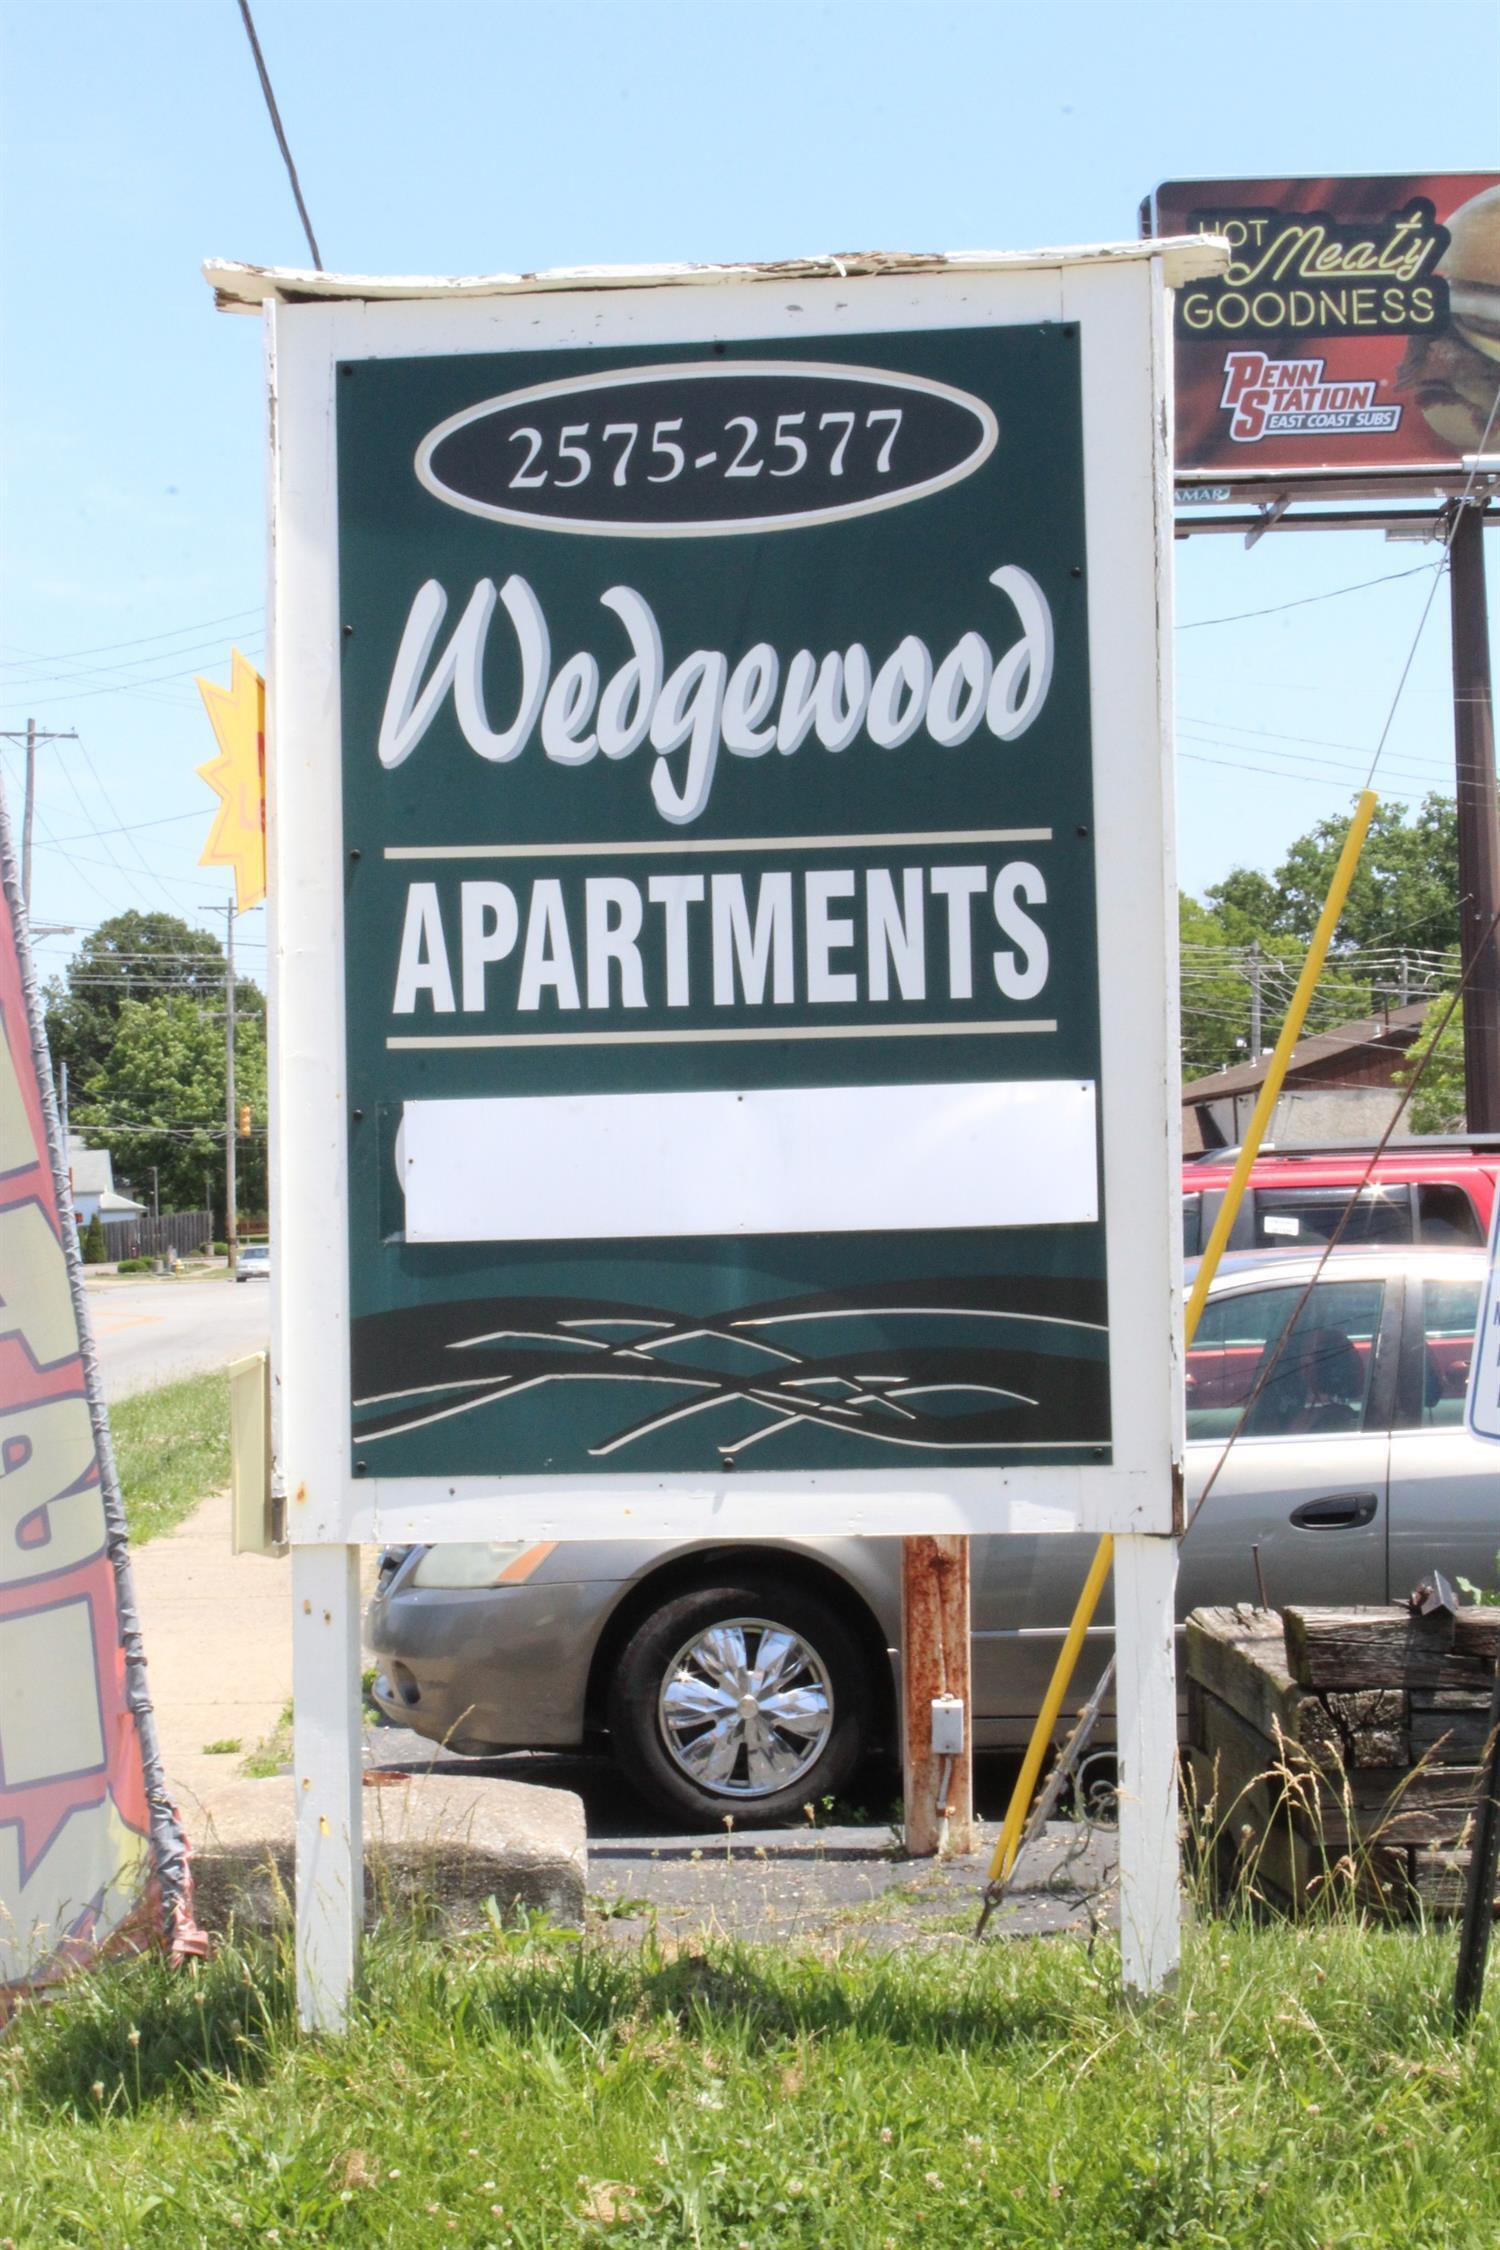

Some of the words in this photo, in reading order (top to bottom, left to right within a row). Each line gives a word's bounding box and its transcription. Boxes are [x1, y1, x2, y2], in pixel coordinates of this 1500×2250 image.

[1199, 220, 1269, 248] HOT
[1223, 211, 1435, 287] Meaty
[1182, 287, 1436, 329] GOODNESS
[507, 408, 904, 490] 2575-2577
[1269, 414, 1306, 429] EAST
[1307, 413, 1354, 428] COAST
[1355, 411, 1393, 427] SUBS
[378, 564, 1055, 826] Wedgewood
[392, 860, 1050, 1015] APARTMENTS
